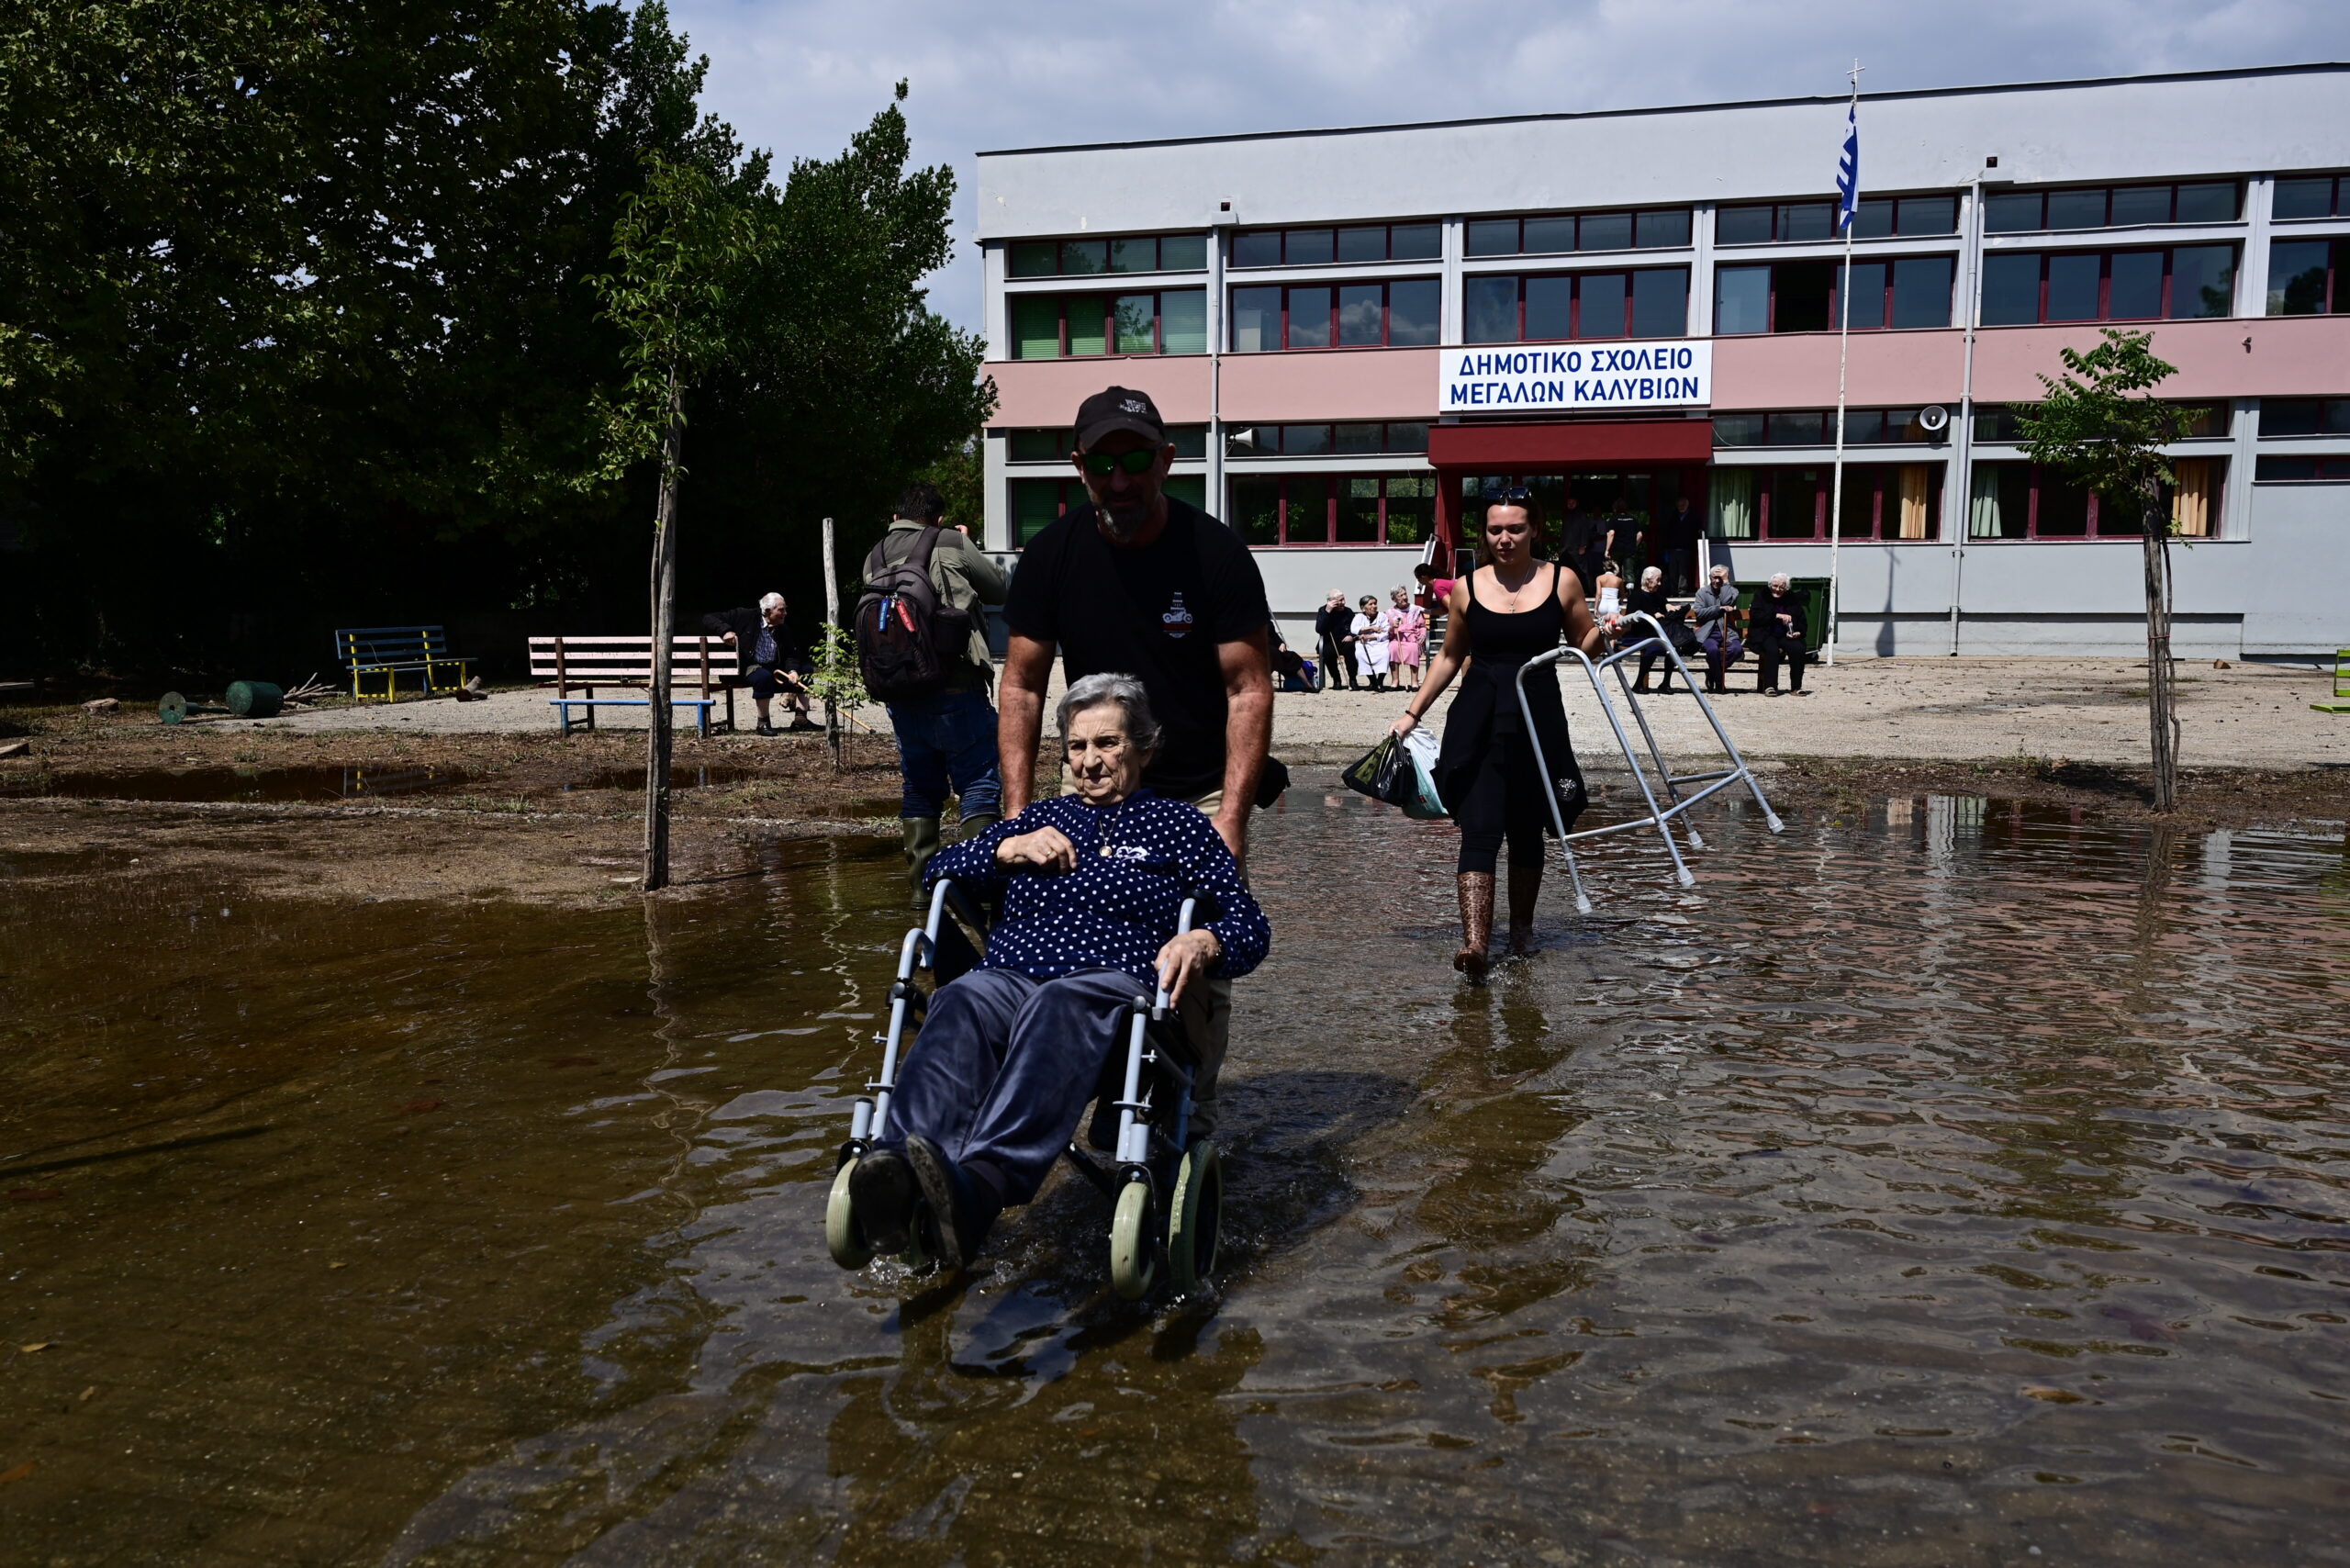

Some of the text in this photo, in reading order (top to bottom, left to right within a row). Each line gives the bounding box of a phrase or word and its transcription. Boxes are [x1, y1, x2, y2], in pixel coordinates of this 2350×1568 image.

[1460, 347, 1692, 376] ΔΗΜΟΤΙΚΟ ΣΧΟΛΕΙΟ
[1450, 376, 1698, 405] ΜΕΓΑΛΩΝ ΚΑΛΥΒΙΩΝ
